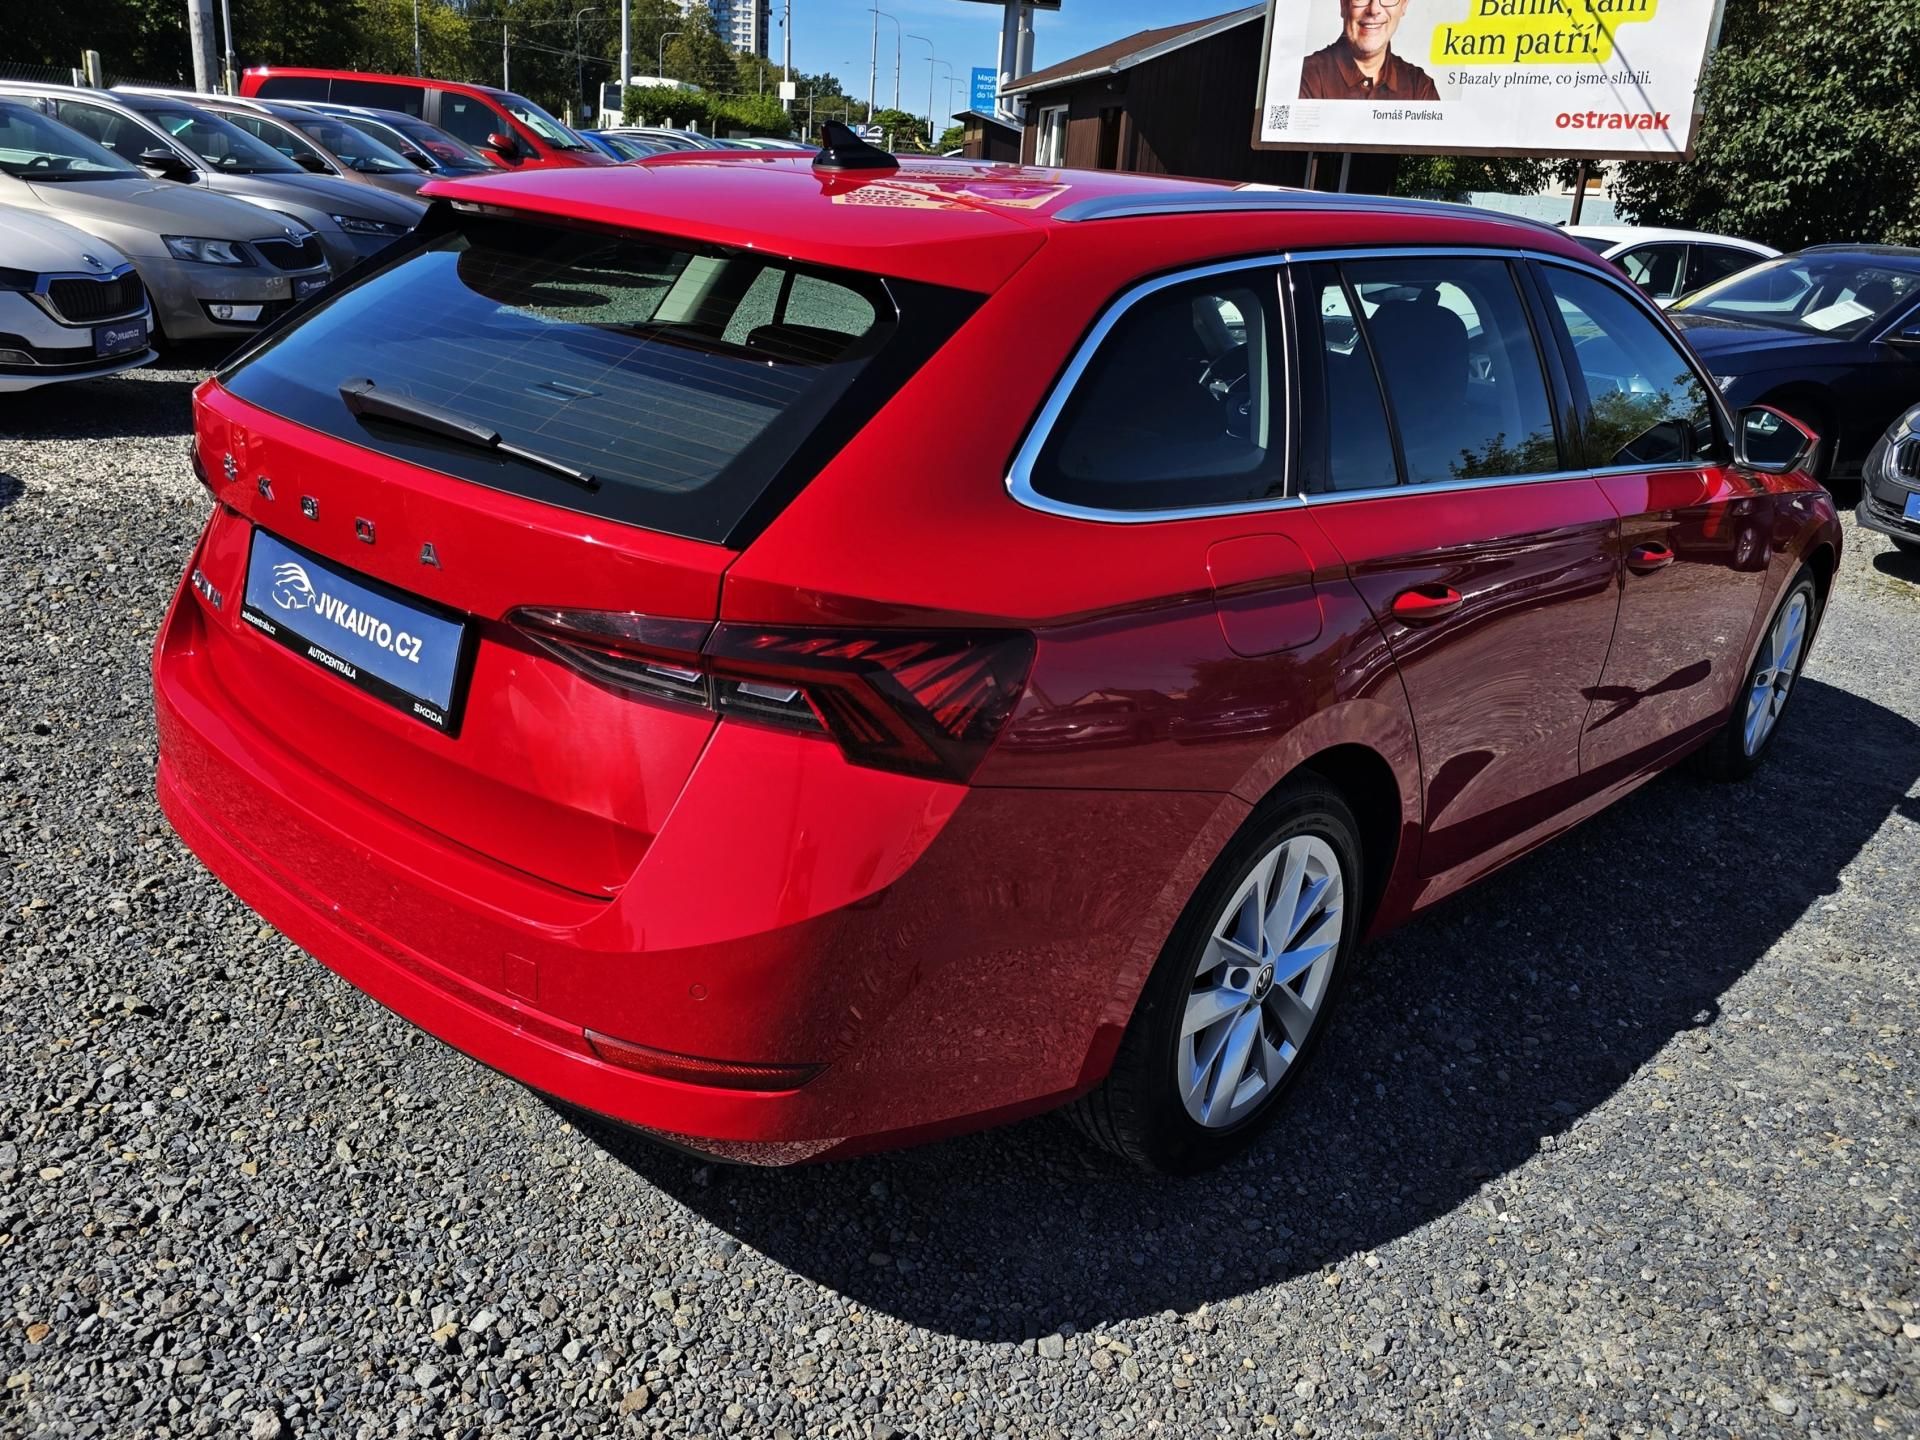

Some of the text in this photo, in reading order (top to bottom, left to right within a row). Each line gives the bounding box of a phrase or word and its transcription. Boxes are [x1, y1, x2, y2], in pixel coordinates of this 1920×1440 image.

[1443, 24, 1602, 62] kam patří!
[1448, 71, 1652, 88] S Bazaly plníme, co jsme slíbili.
[1372, 109, 1443, 121] Tomáš Pavliska
[1555, 111, 1670, 130] ostravak
[314, 592, 423, 664] JVKAUTO.CZ
[307, 645, 356, 680] AUTOCENTRÁLA
